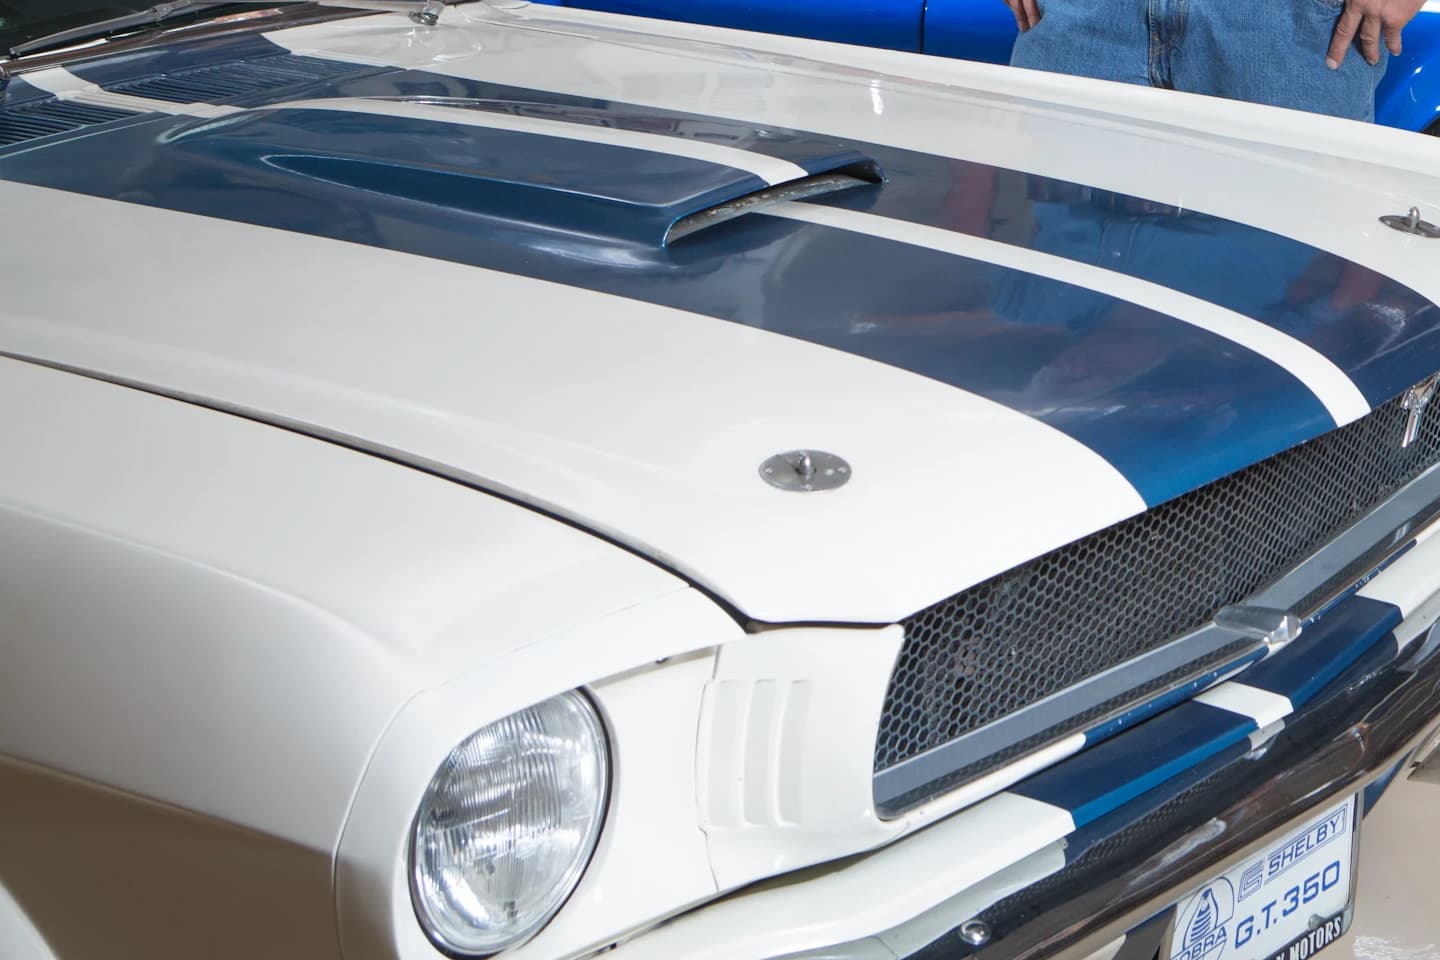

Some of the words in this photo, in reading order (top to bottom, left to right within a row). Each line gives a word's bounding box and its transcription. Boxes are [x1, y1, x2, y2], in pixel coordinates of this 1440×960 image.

[1268, 818, 1341, 876] SHELBY
[1177, 926, 1227, 960] OBRA
[1289, 917, 1342, 960] MOTORS
